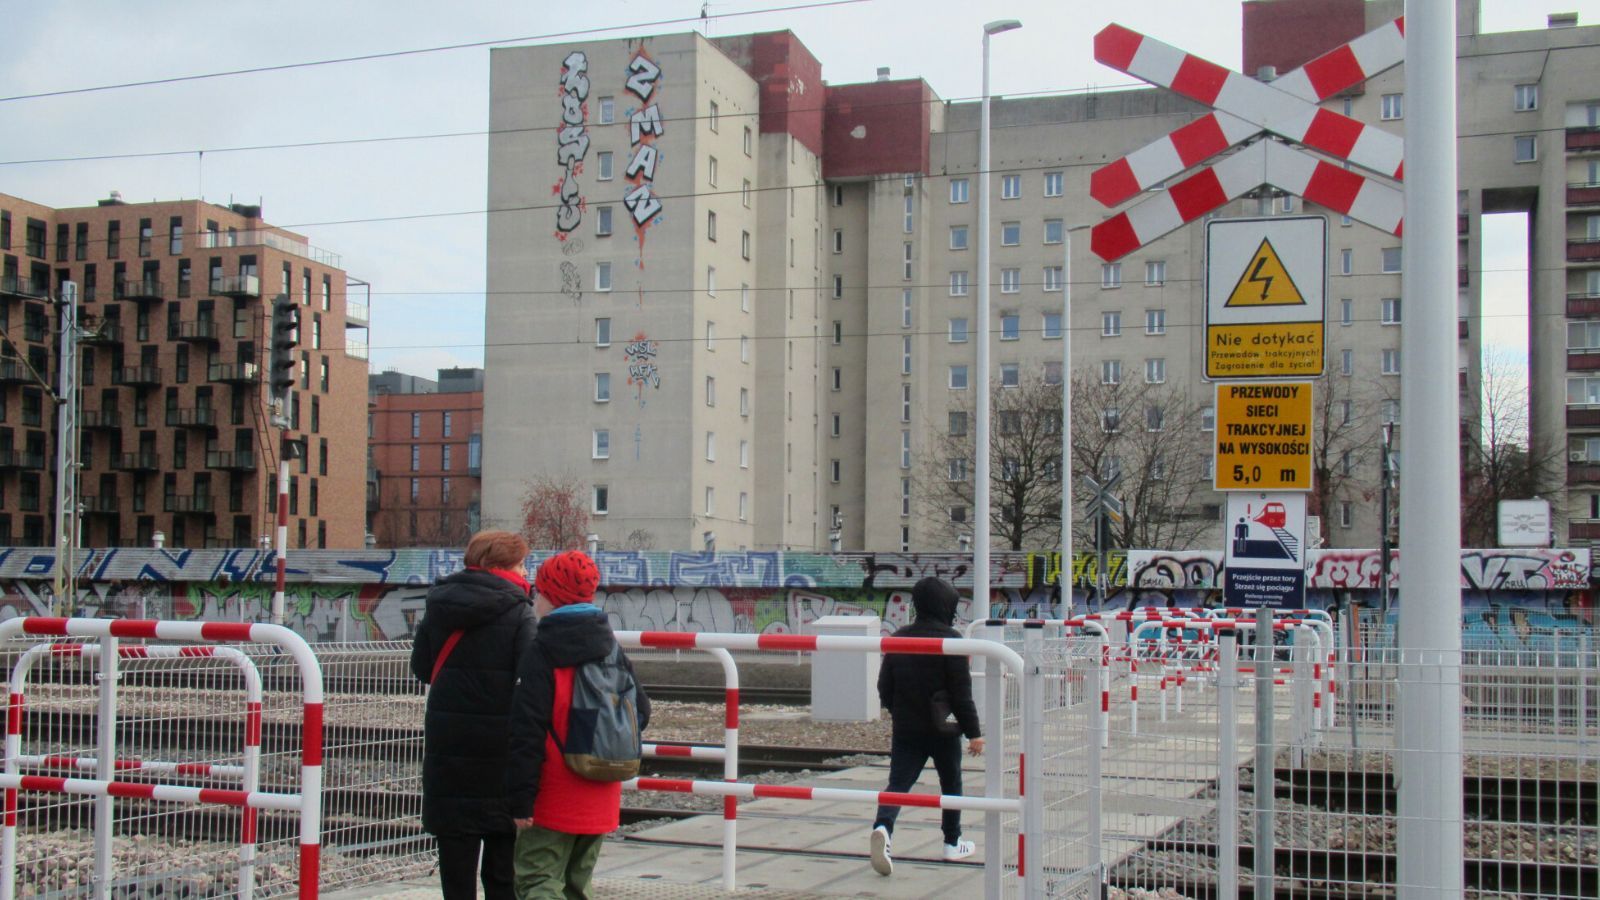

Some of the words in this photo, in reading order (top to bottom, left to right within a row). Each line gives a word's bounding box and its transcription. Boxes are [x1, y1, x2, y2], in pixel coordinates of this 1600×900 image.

[1216, 334, 1242, 346] Nie
[1251, 331, 1315, 348] dotykać
[1269, 360, 1284, 368] dla
[1231, 386, 1299, 398] PRZEWODY
[1246, 405, 1279, 417] SIECI
[1226, 423, 1306, 436] TRAKCYJNEJ
[1218, 442, 1234, 454] NA
[1240, 439, 1310, 455] WYSOKOŚCI
[1233, 464, 1262, 485] 5,0
[1280, 468, 1296, 482] m
[1282, 575, 1297, 583] tory
